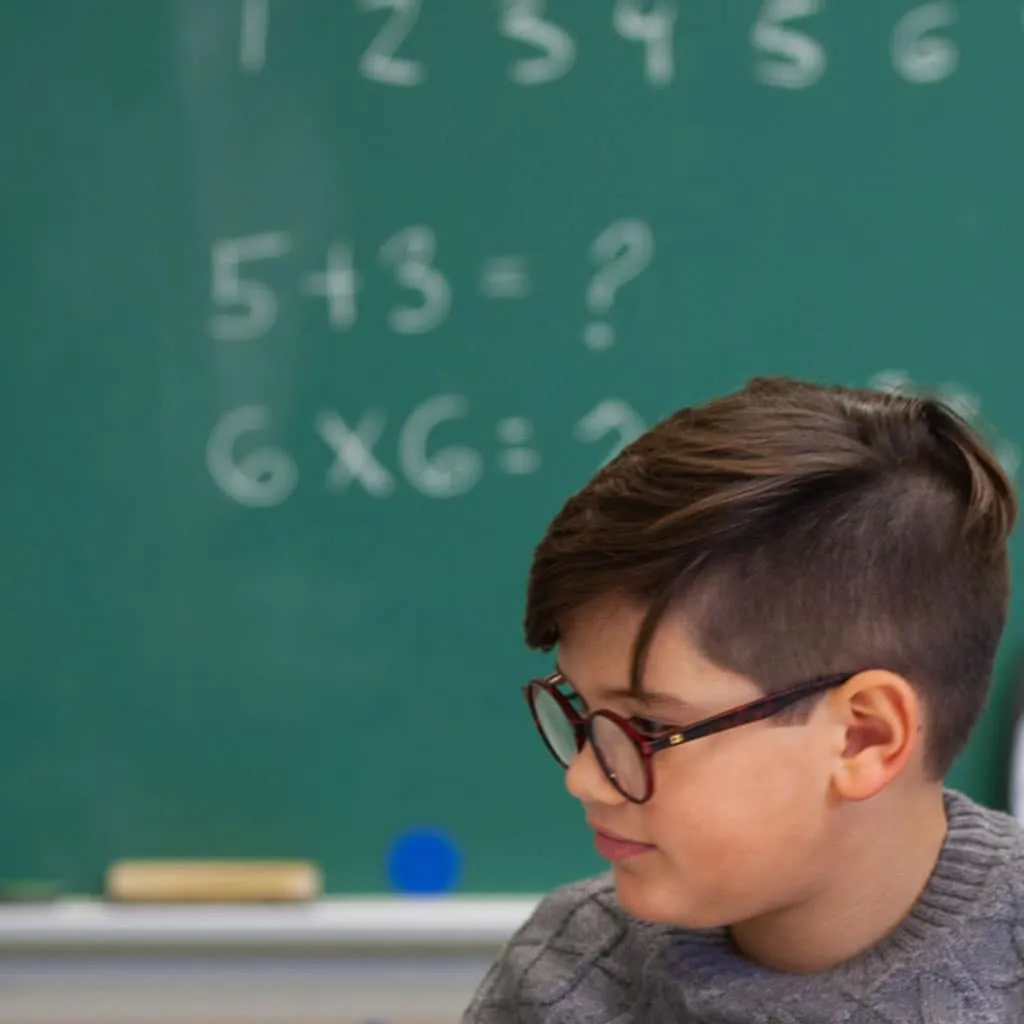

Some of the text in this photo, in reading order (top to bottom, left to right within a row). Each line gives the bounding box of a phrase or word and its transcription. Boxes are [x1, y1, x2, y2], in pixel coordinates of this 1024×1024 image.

[239, 0, 960, 89] 1 2 3 4 5 6
